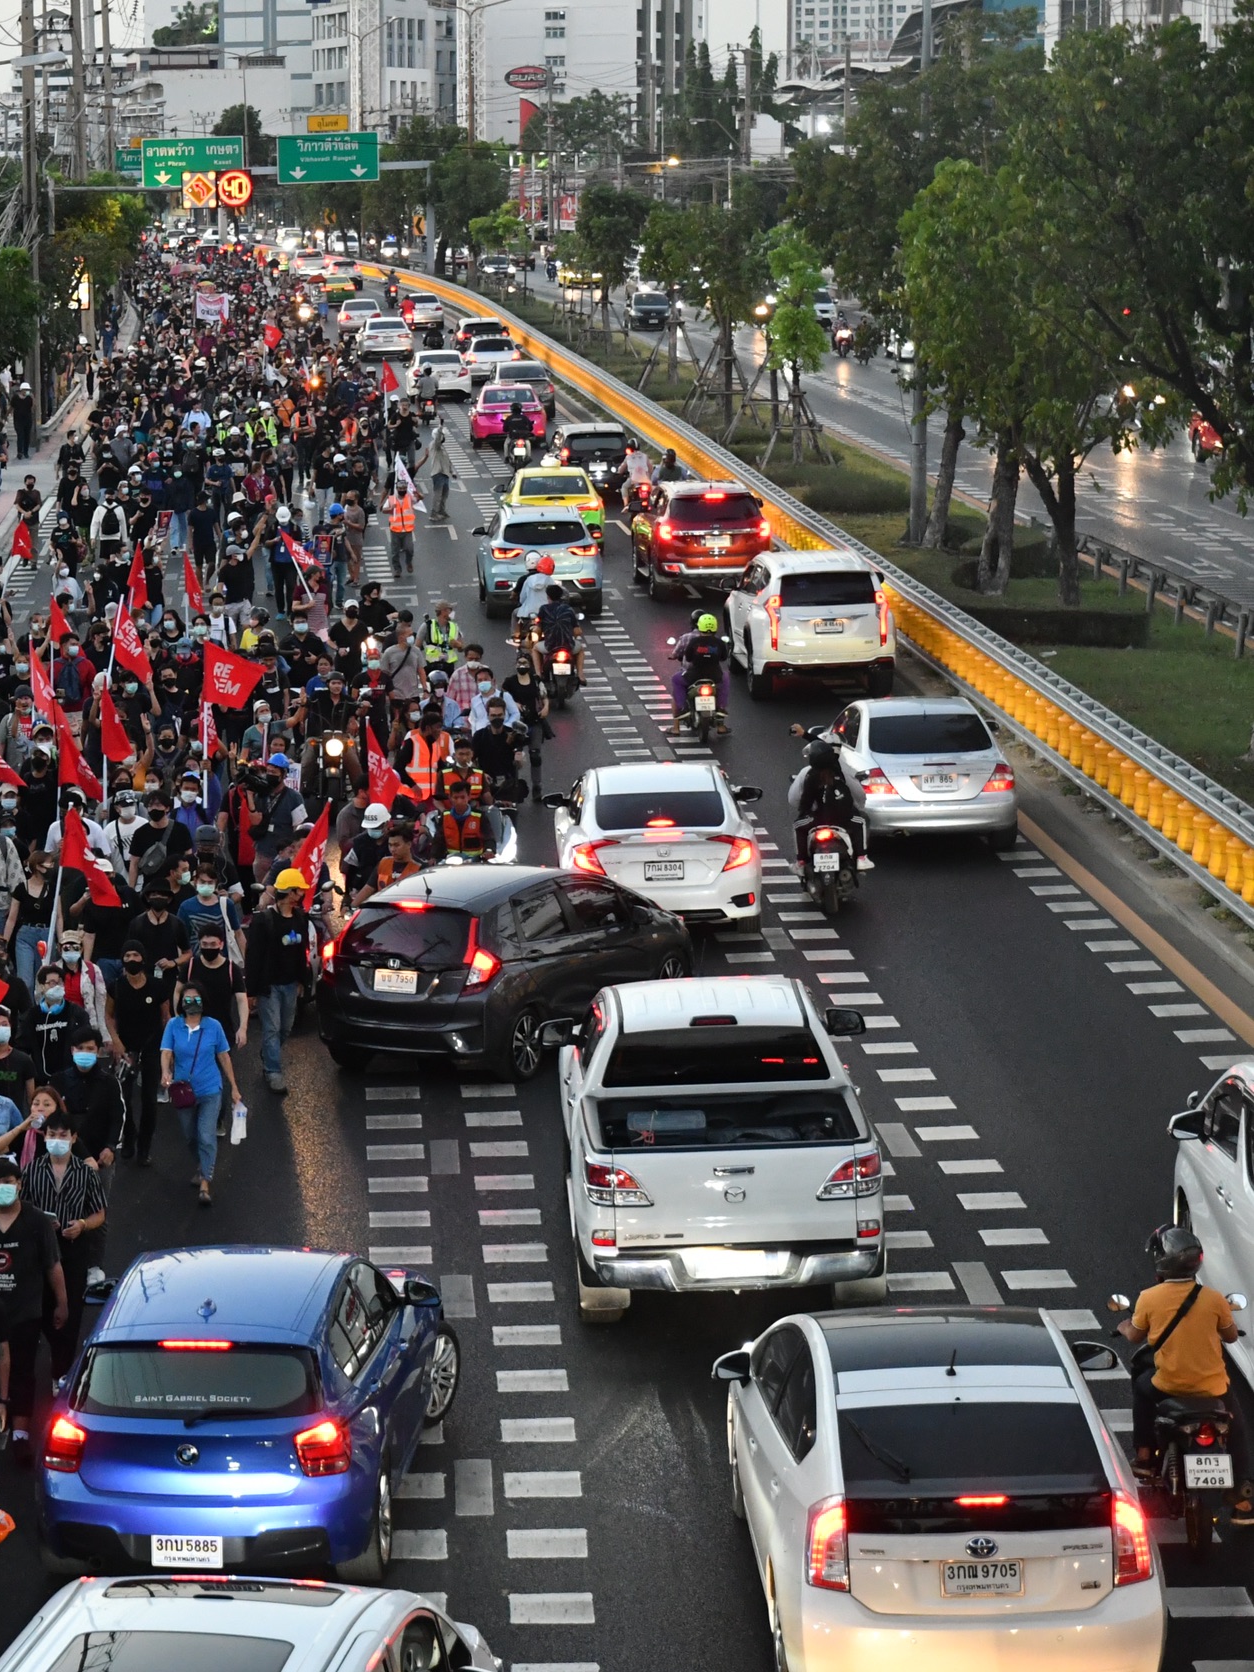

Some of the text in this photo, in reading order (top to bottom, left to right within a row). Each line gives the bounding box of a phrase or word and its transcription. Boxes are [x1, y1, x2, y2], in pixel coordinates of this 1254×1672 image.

[146, 142, 239, 157] ลาดพร้าว เกษตร
[224, 178, 246, 198] 40
[213, 662, 234, 679] RE
[664, 863, 682, 871] 8304
[396, 975, 414, 984] 7950
[134, 1395, 252, 1403] SAINT GABRIEL SOCIETY
[1194, 1477, 1225, 1486] 7408
[186, 1539, 218, 1552] 5885
[981, 1564, 1017, 1578] 9705
[956, 1582, 1010, 1592] กรุงเทพมหานคร
